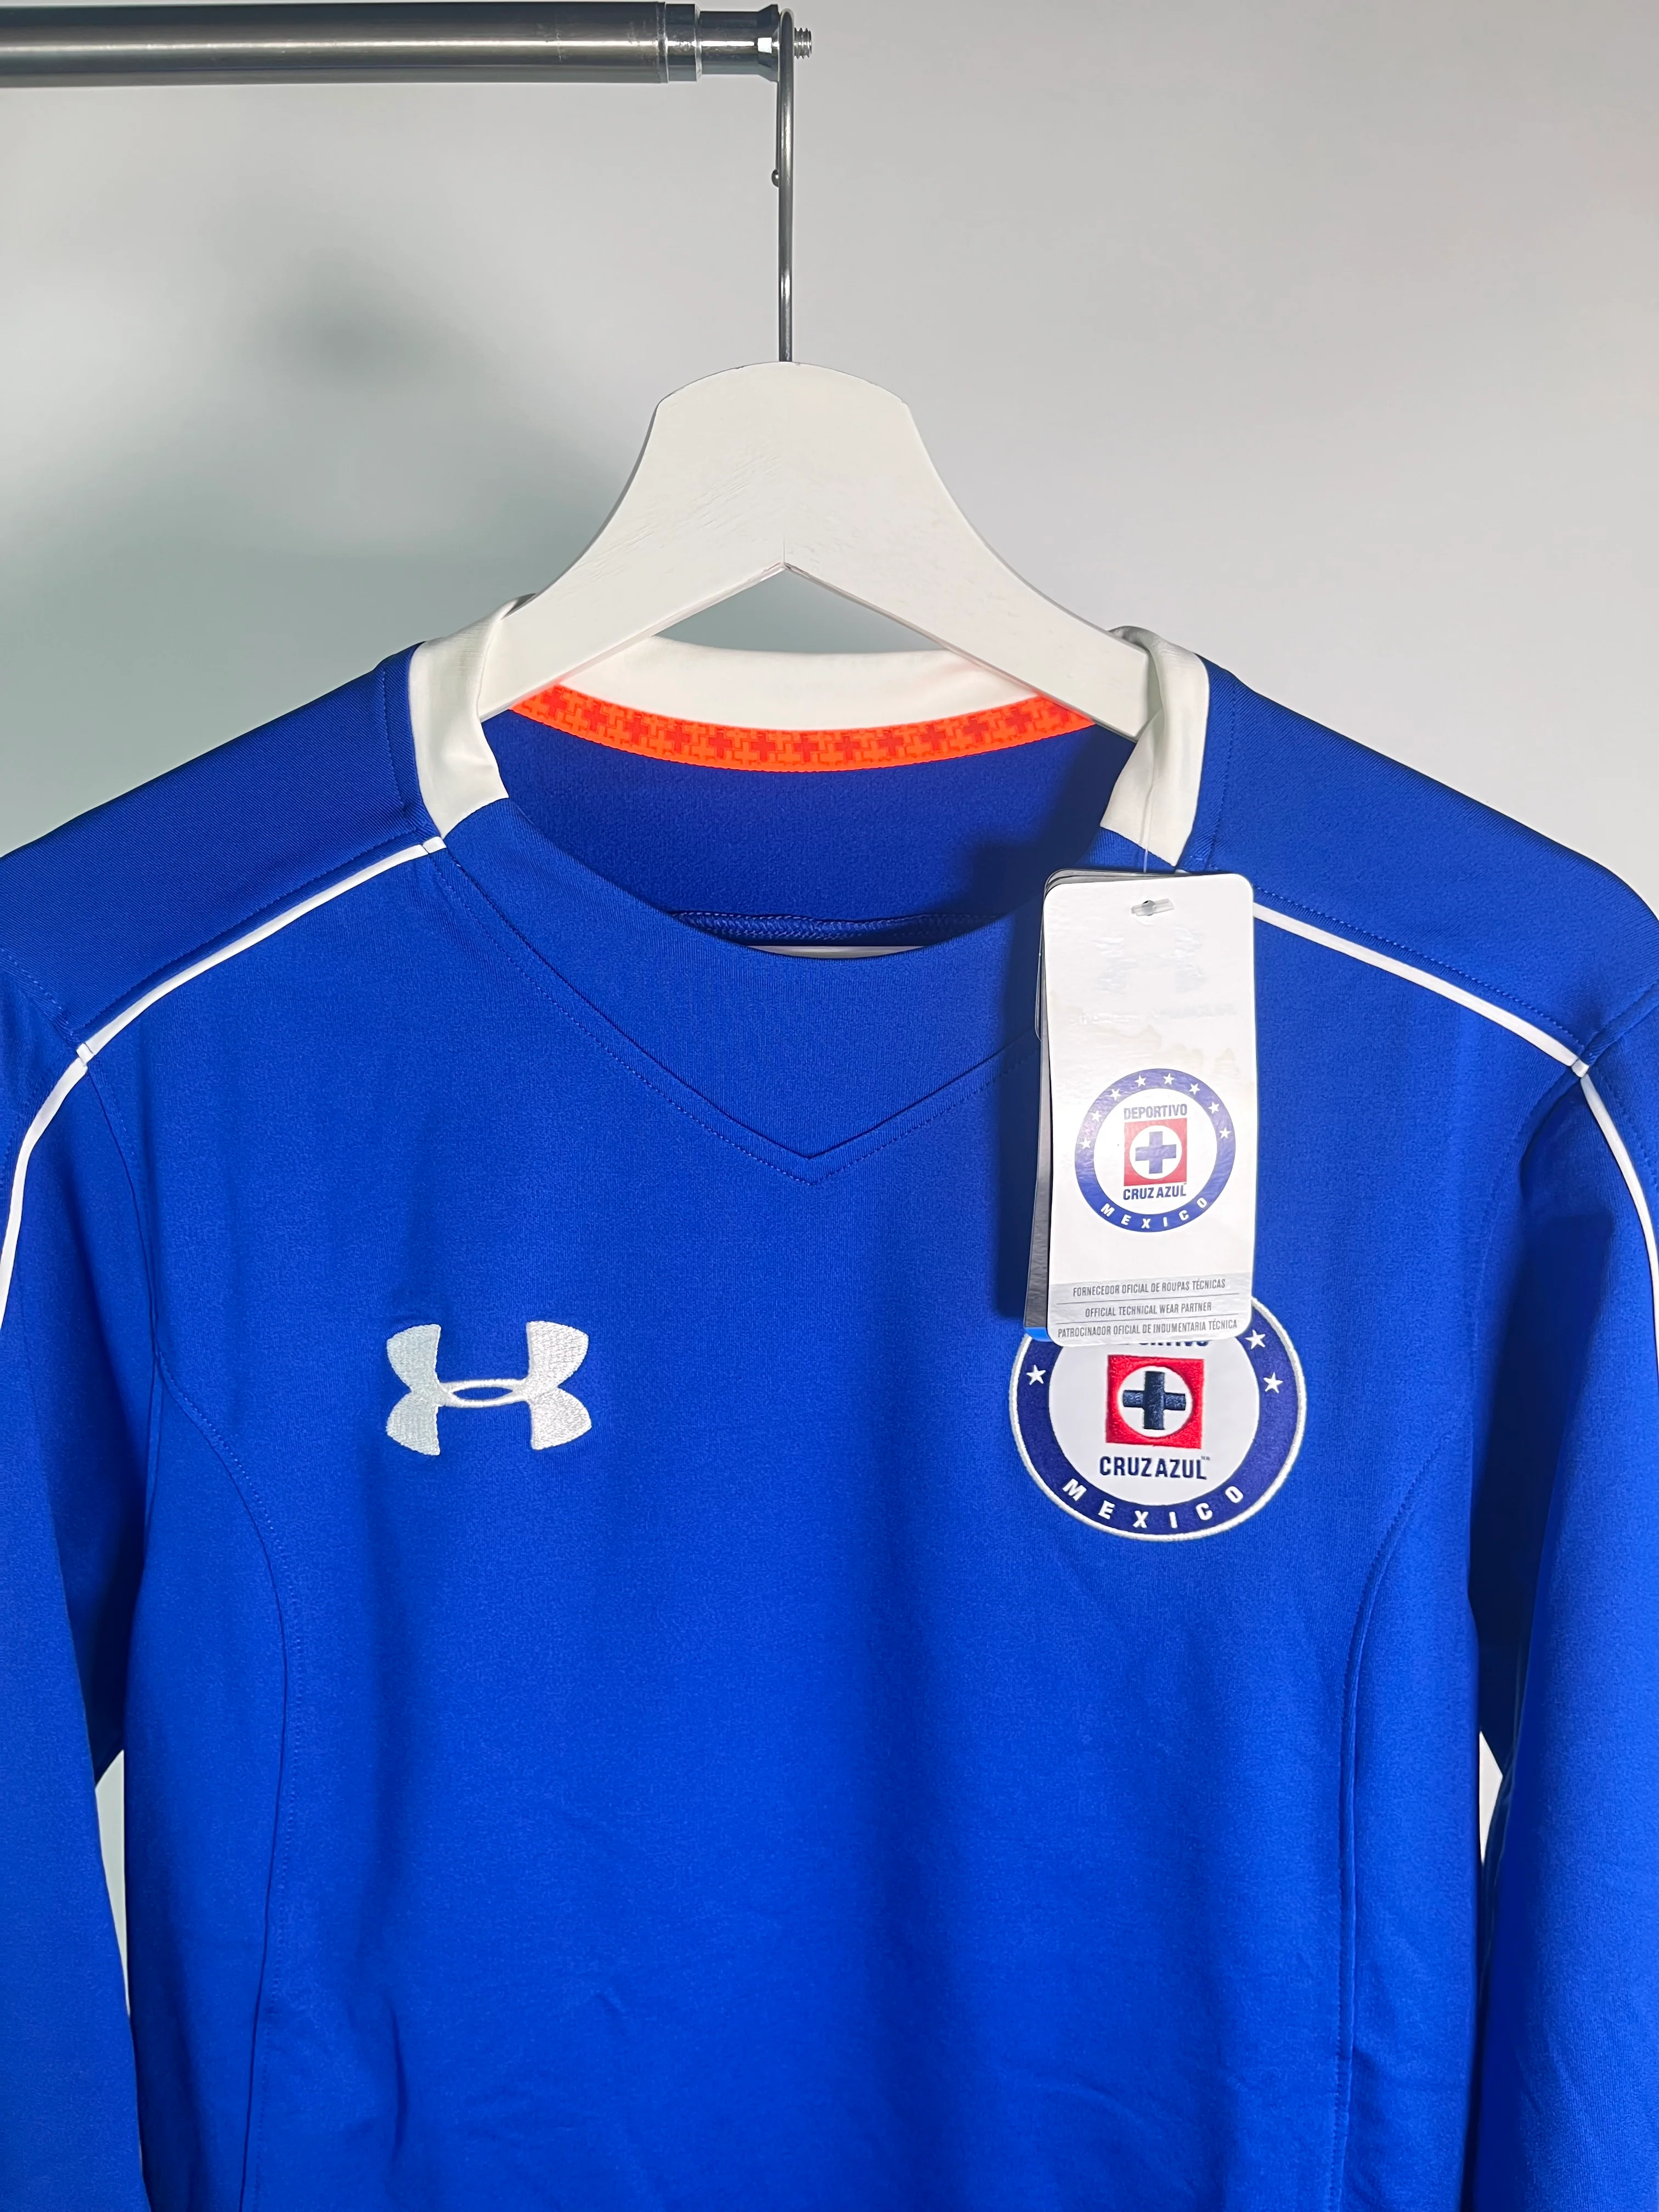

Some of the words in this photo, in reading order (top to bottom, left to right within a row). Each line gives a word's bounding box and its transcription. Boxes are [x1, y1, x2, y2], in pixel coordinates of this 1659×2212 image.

[1124, 1103, 1188, 1120] DEPORTIVO
[1122, 1188, 1154, 1200] CRUZ
[1156, 1185, 1187, 1198] AZUL
[1101, 1197, 1207, 1229] MEXICO
[1073, 1284, 1120, 1297] FORNECEDOR
[1121, 1283, 1149, 1294] OFICIAL
[1151, 1282, 1160, 1292] DE
[1162, 1281, 1190, 1291] ROUPAS
[1192, 1278, 1226, 1290] TÉCNICAS
[1085, 1307, 1116, 1317] OFFICIAL
[1119, 1305, 1157, 1316] TECHNICAL
[1159, 1304, 1178, 1313] WEAR
[1181, 1302, 1212, 1313] PARTNER
[1058, 1325, 1111, 1338] PATROCINADOR
[1113, 1324, 1141, 1335] OFICIAL
[1142, 1324, 1152, 1334] DE
[1153, 1321, 1206, 1333] INDUMENTARIA
[1209, 1318, 1237, 1330] TÉCNICA
[1099, 1455, 1152, 1477] CRUZ
[1155, 1458, 1207, 1480] AZUL
[1063, 1478, 1244, 1529] MEXICO
